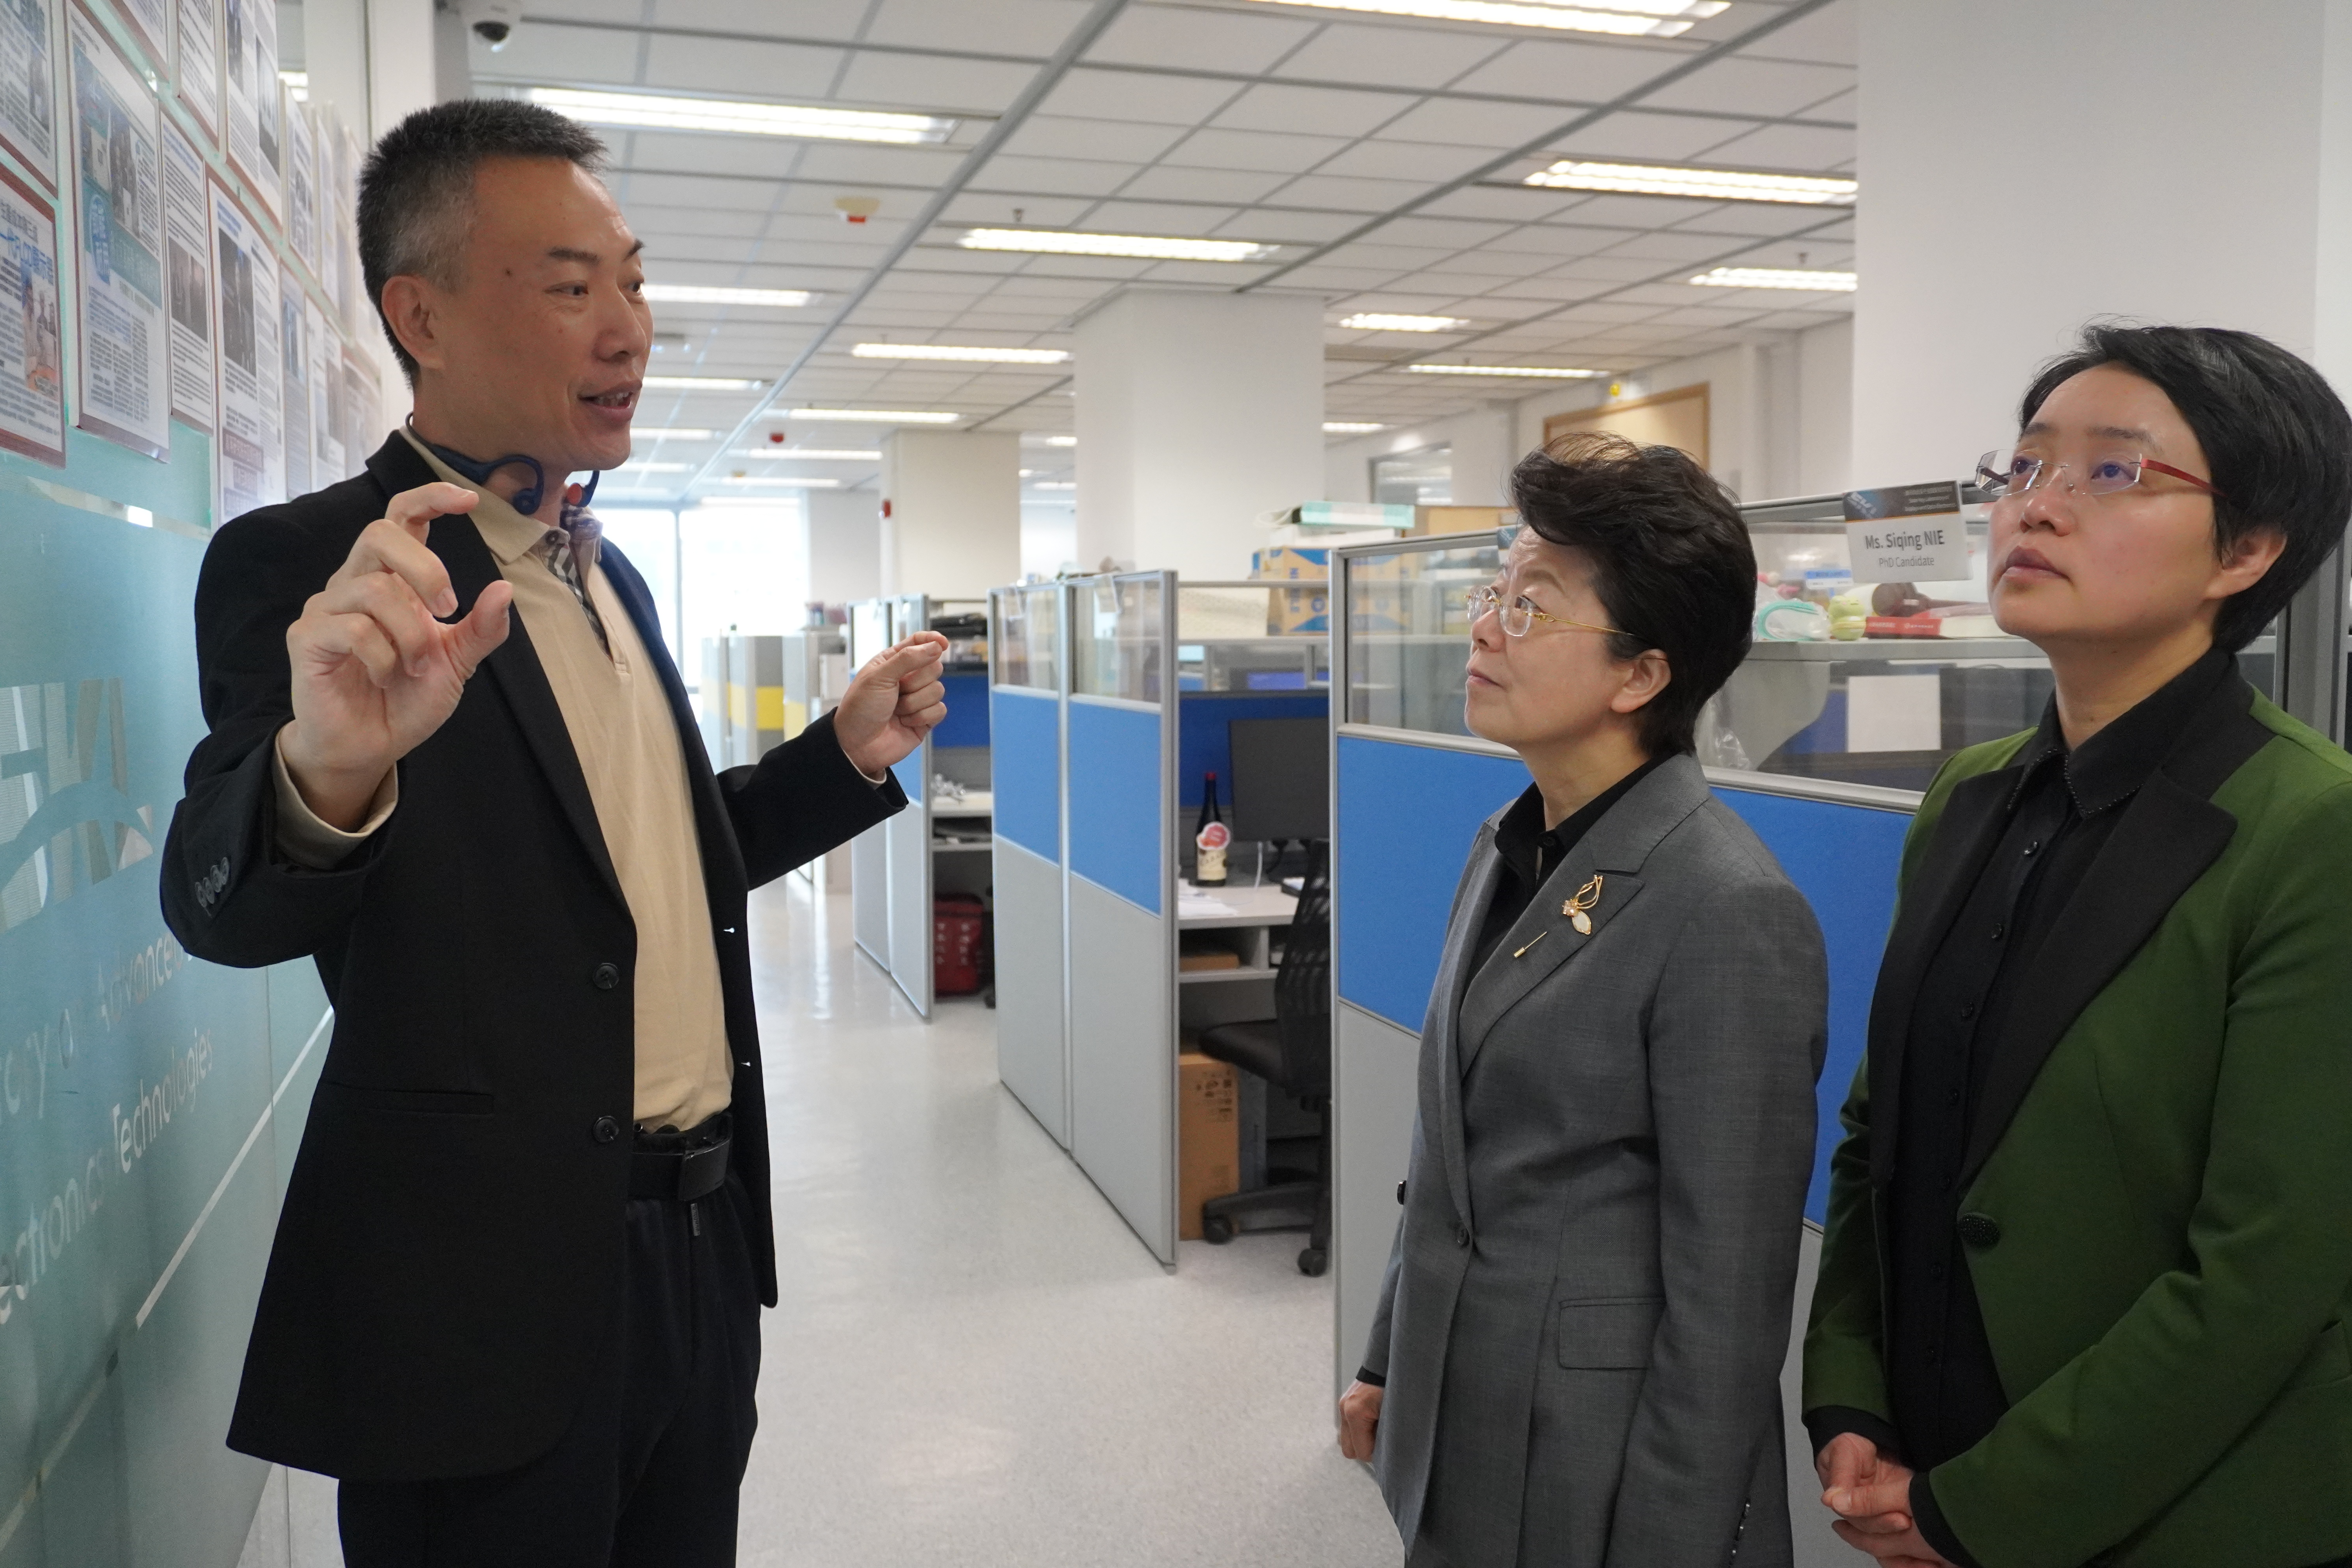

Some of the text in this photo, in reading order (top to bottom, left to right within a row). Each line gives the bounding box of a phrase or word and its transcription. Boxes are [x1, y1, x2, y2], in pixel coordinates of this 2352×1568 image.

[1865, 530, 1945, 551] Ms. Siqing NIE
[1879, 556, 1935, 568] PhD Candidate
[112, 1027, 212, 1176] Technologies
